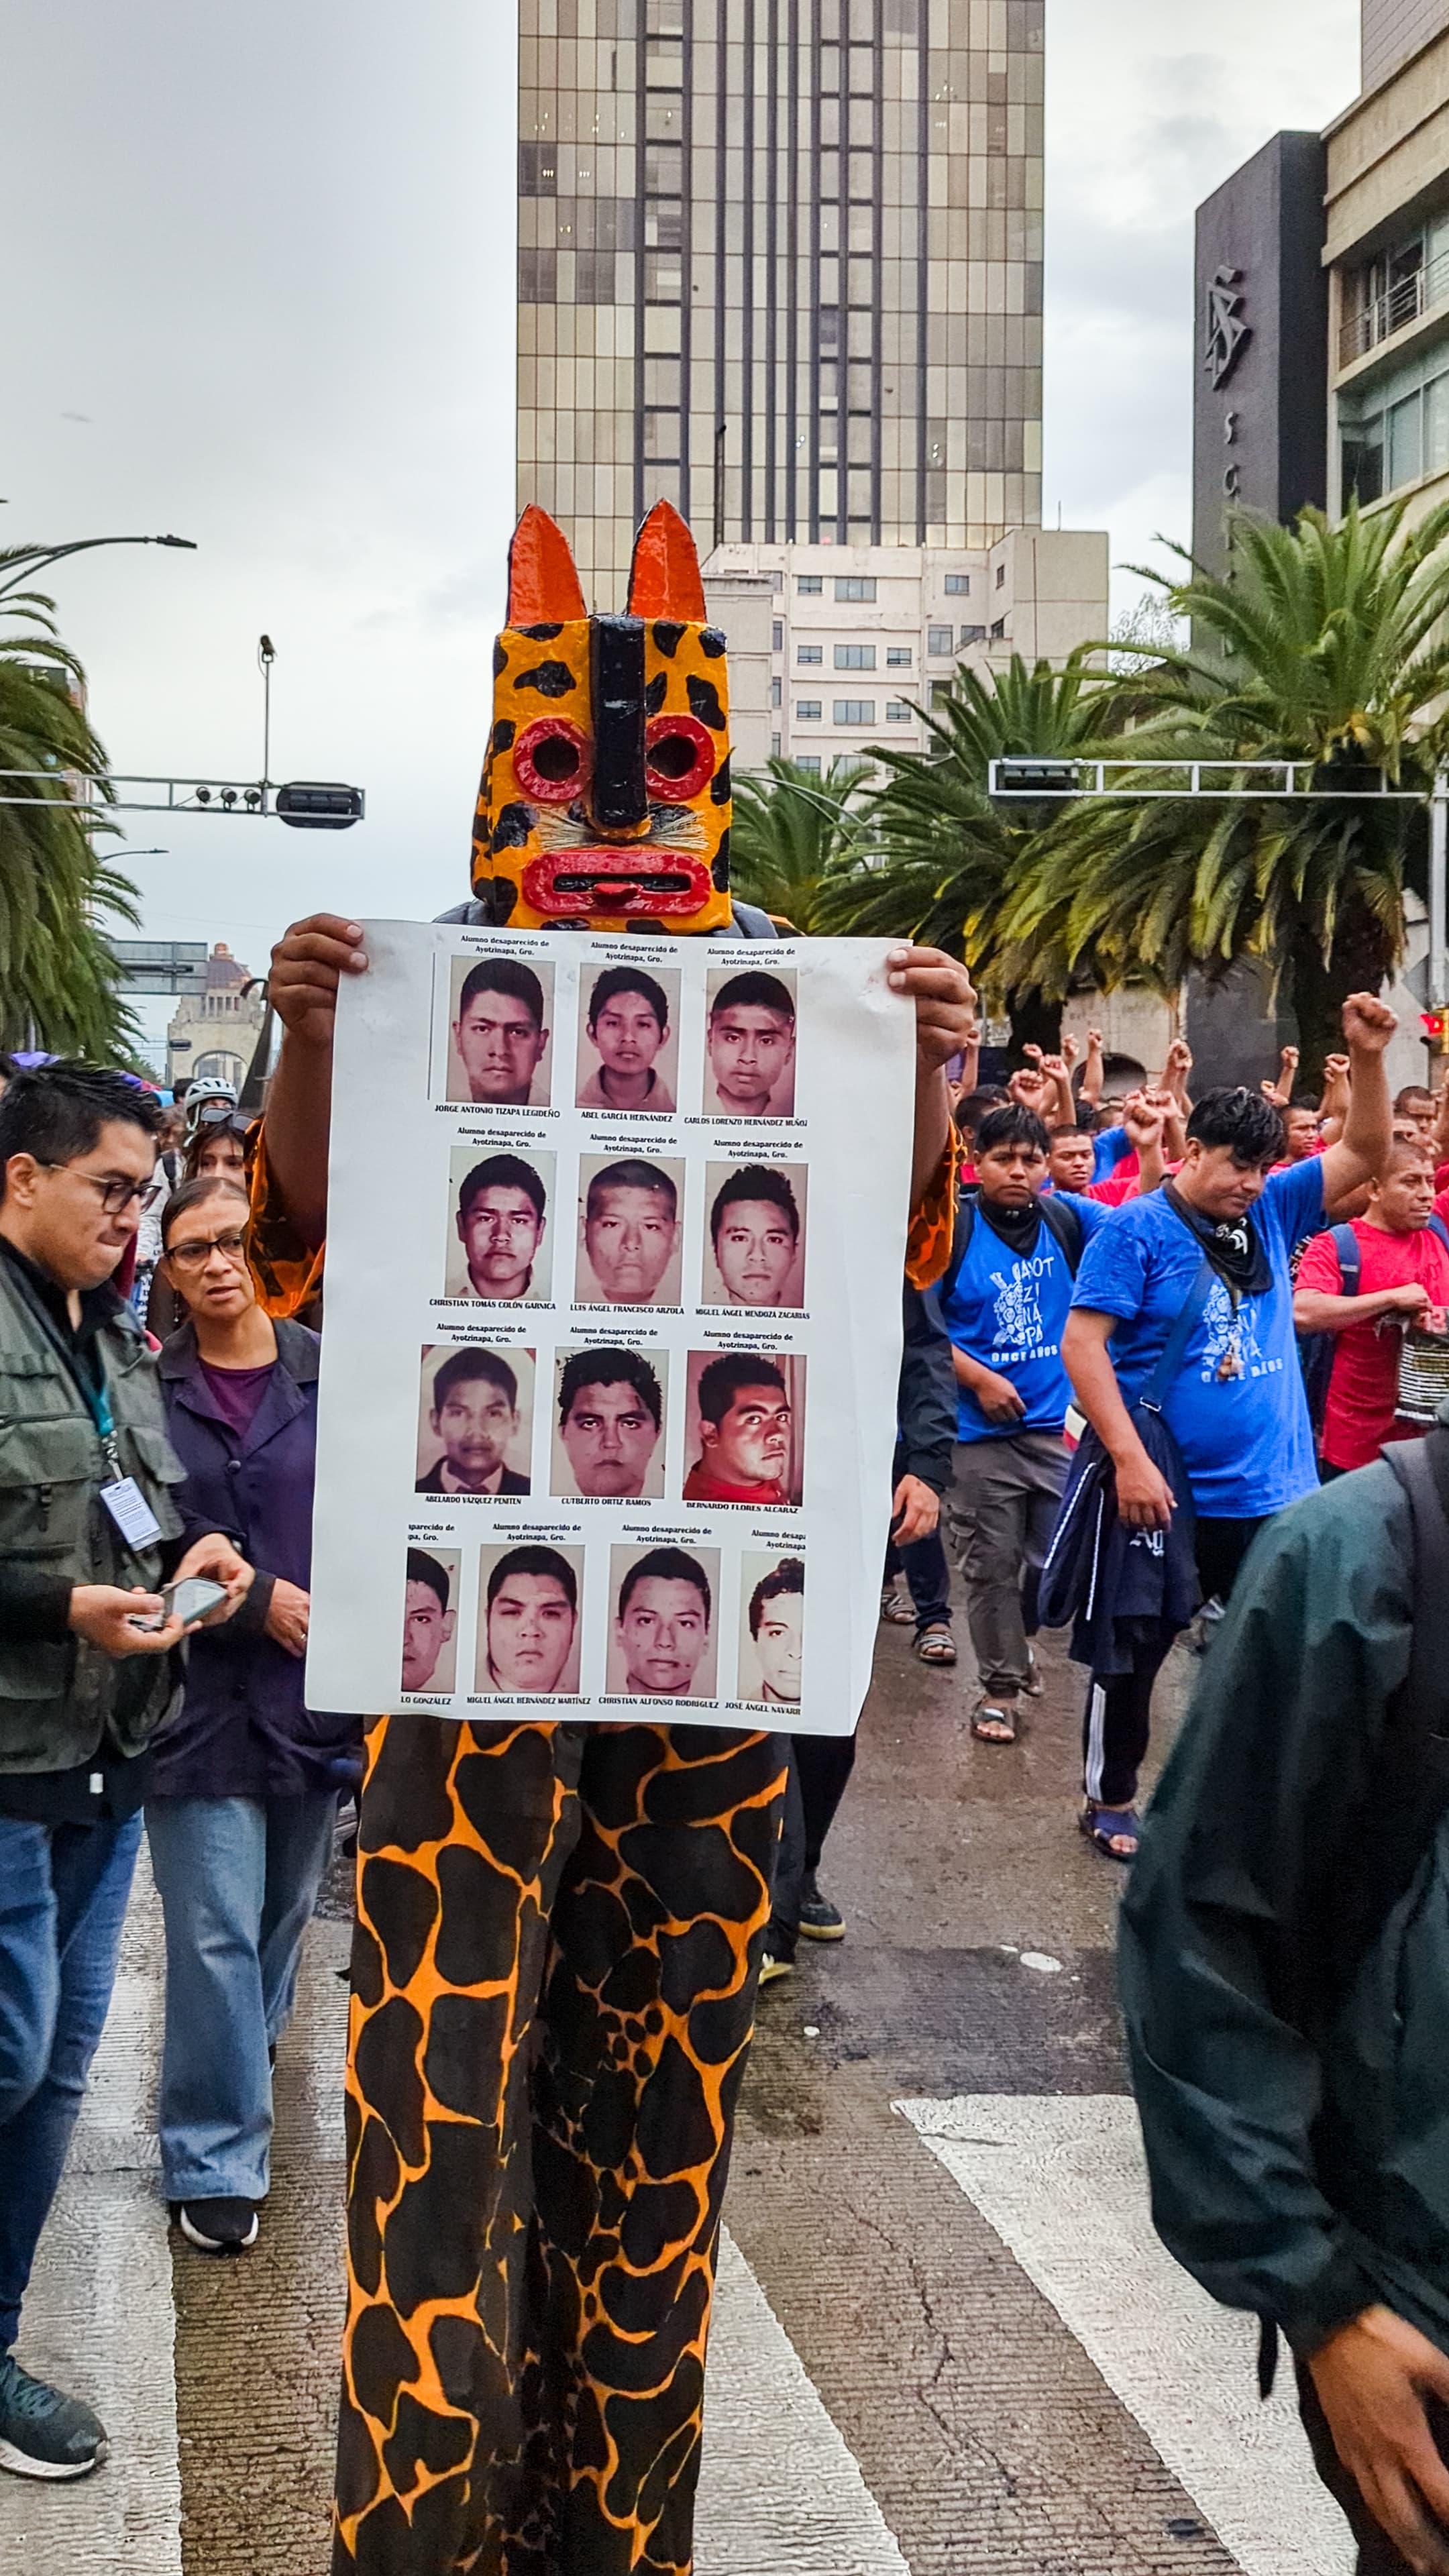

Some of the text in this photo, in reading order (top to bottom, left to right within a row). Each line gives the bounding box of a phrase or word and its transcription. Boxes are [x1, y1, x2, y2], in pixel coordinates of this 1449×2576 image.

[490, 938, 538, 946] desaparecido
[620, 944, 667, 953] desaparecido
[737, 949, 784, 957] desaparecido
[523, 1109, 560, 1118] LEGIDEÑO
[488, 1129, 535, 1137] desaparecido
[751, 1529, 780, 1538] Alumno
[676, 1700, 718, 1709] RODRÍGUEZ
[745, 1703, 769, 1712] ÁNGEL
